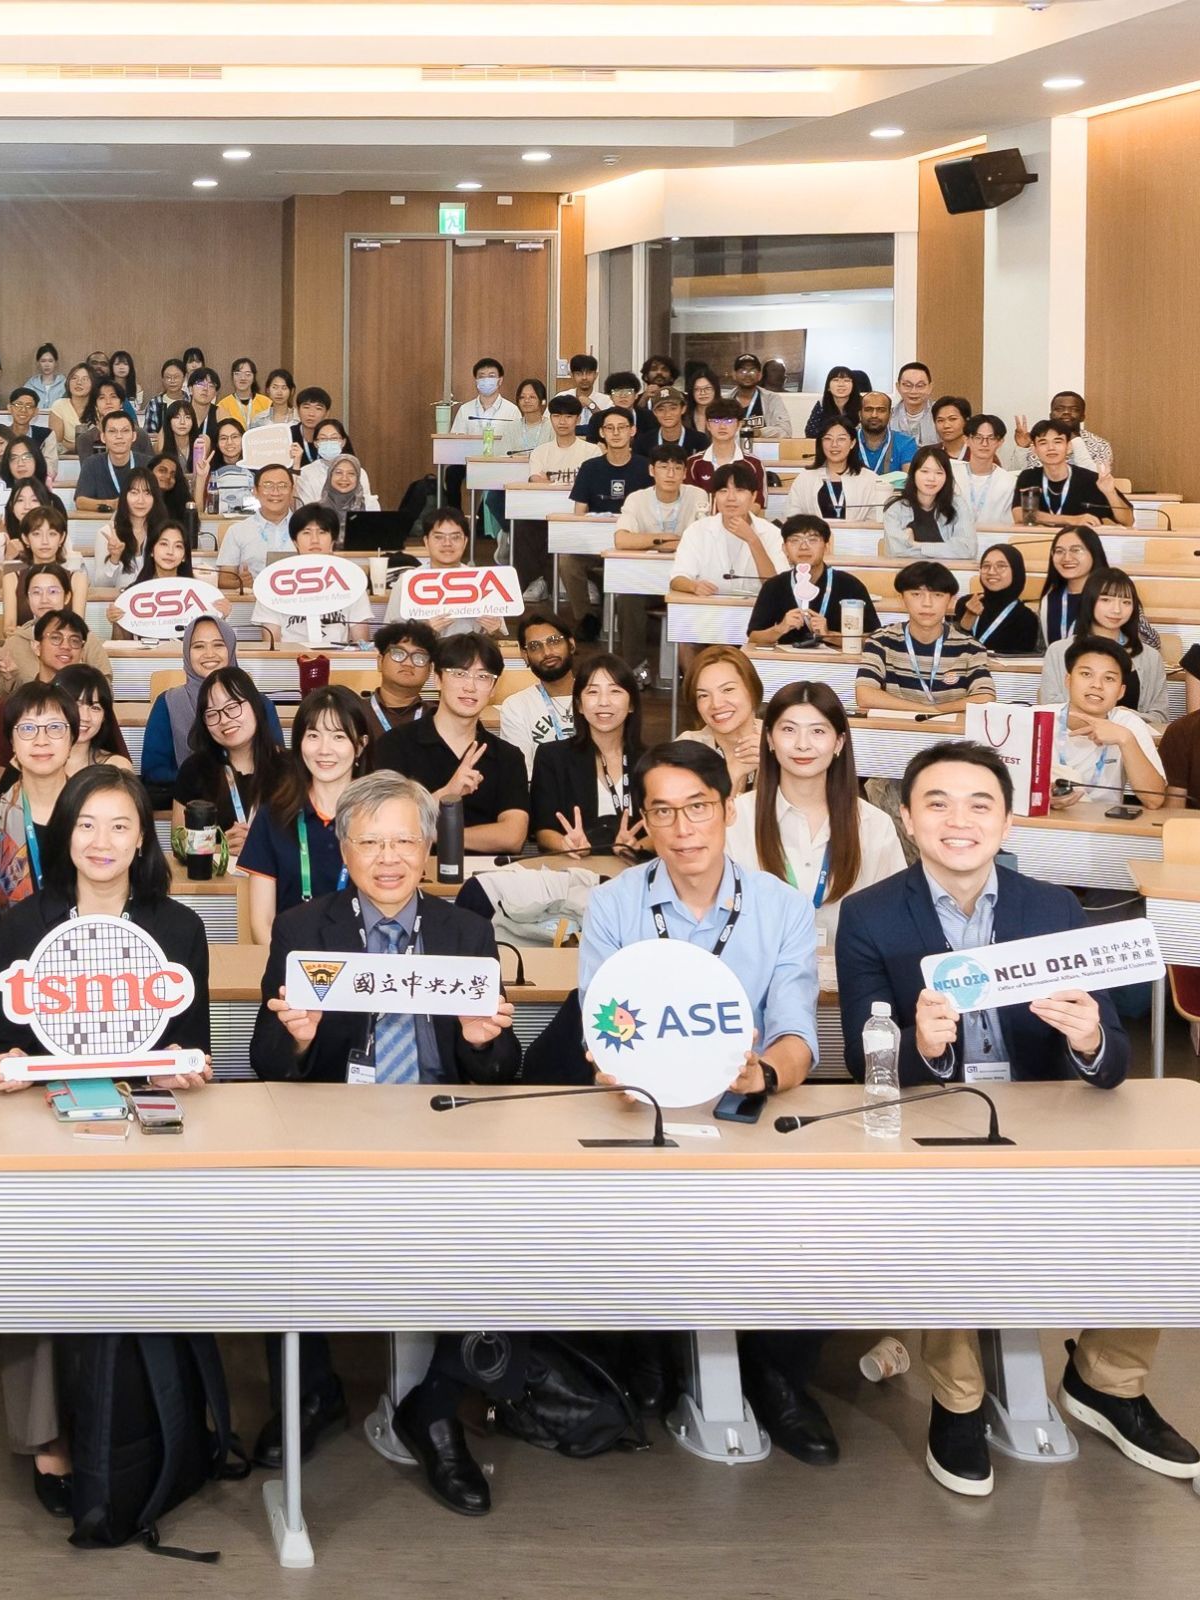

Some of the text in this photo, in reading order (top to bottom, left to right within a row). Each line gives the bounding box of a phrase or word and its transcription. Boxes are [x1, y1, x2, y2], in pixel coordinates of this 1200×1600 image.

[270, 566, 350, 596] GSA
[408, 570, 514, 605] GSA
[130, 588, 208, 618] GSA
[408, 604, 508, 617] Where Leaders Meet
[1089, 937, 1152, 957] 國立中央大學
[1092, 948, 1155, 967] 國際事務處
[933, 973, 990, 992] NCU OIA
[994, 953, 1088, 982] NCU OIA
[5, 968, 185, 1015] tsmc
[352, 970, 491, 1000] 國立中央大學
[657, 1001, 743, 1039] ASE
